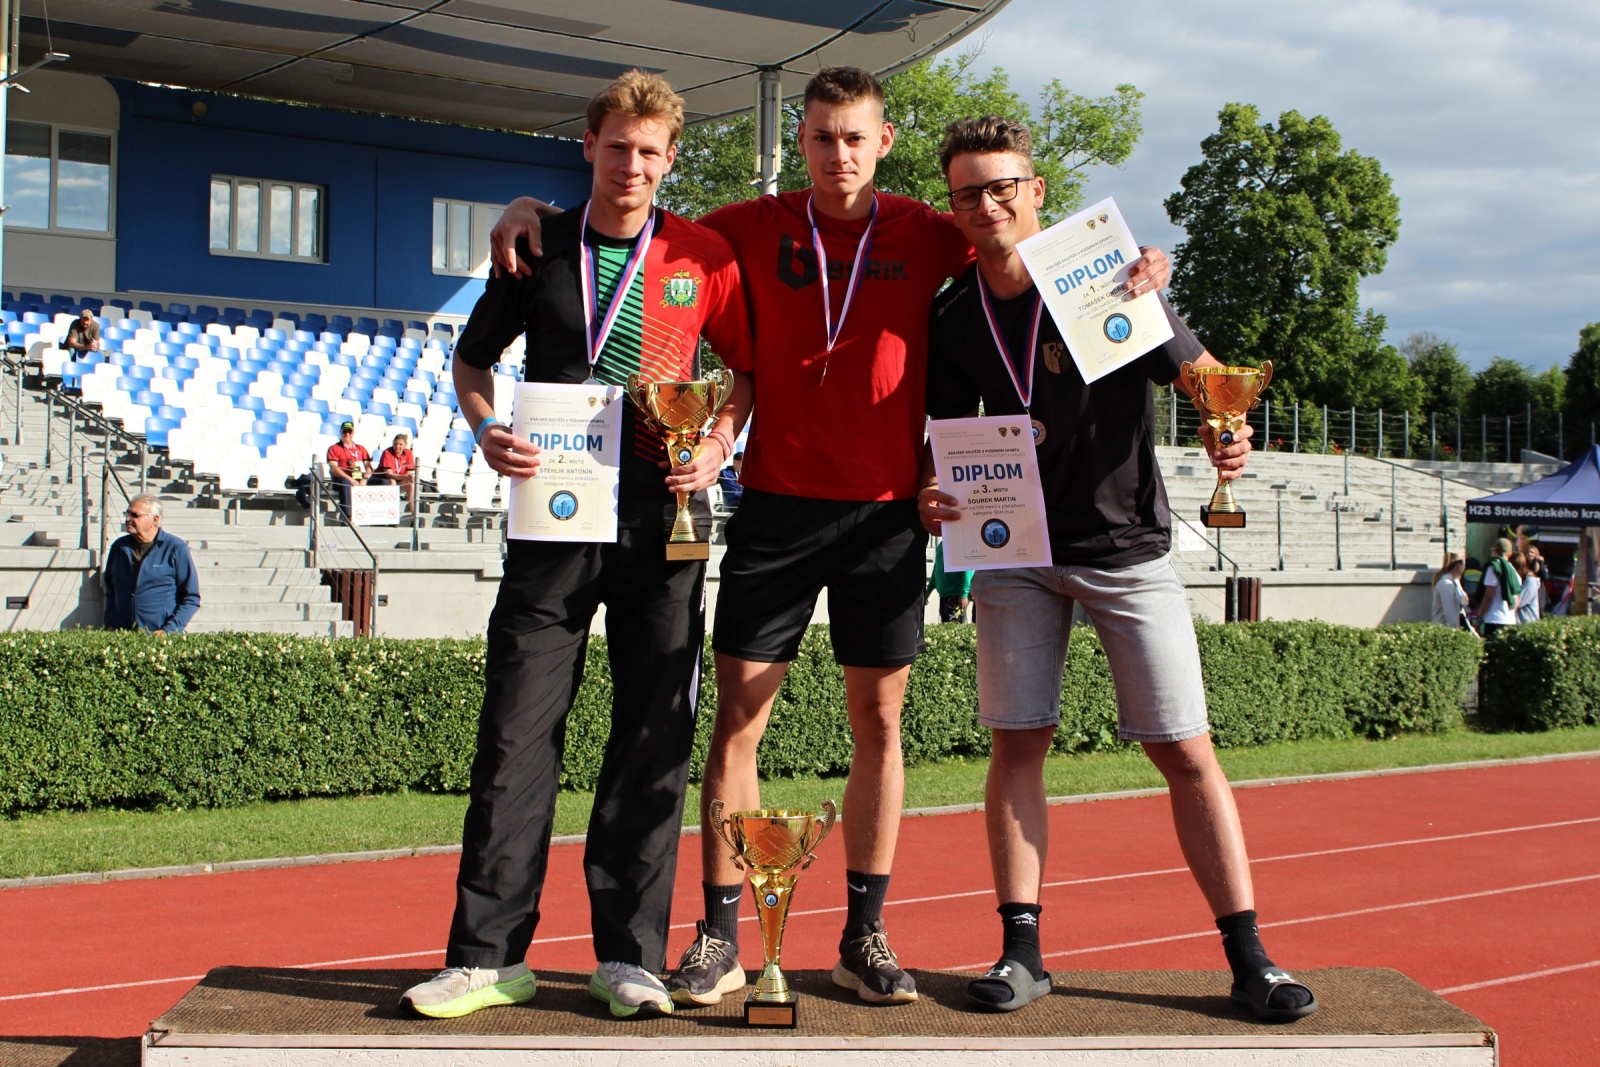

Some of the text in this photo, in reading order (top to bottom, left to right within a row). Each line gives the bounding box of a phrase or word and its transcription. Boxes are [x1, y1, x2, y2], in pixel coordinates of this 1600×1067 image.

[1054, 249, 1125, 295] DIPLOM
[1090, 285, 1100, 293] 1.
[1078, 294, 1106, 311] TOMÁŠEK
[530, 433, 602, 451] DIPLOM
[558, 454, 567, 463] 2.
[952, 463, 1022, 482] DIPLOM
[982, 484, 991, 493] 3.
[1469, 505, 1600, 521] HZS Středočeského kra
